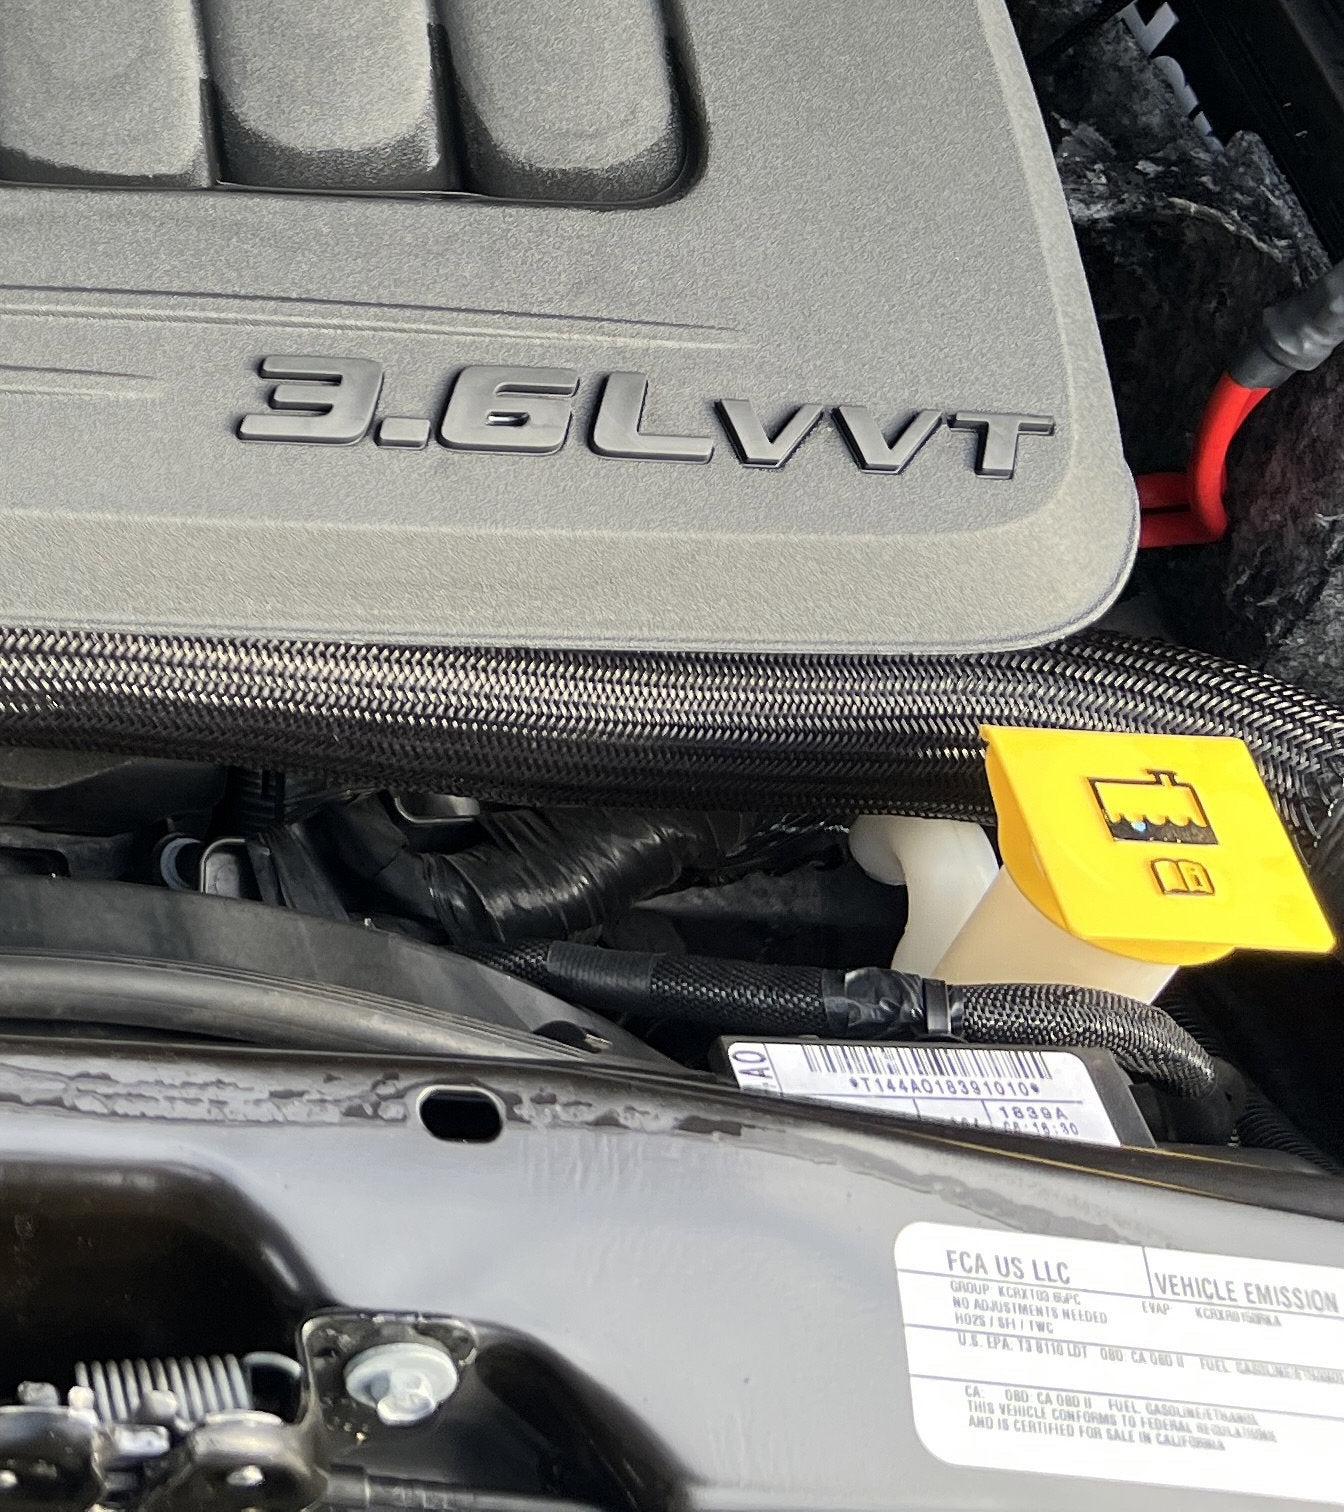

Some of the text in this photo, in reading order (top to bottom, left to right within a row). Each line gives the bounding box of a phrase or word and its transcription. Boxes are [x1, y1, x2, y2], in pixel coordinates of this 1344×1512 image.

[236, 354, 1056, 480] 3.6L VVT
[946, 1250, 1070, 1284] FCA US LLC
[1154, 1272, 1340, 1313] VEHICLE EMISSION
[953, 1296, 1107, 1324] NO ADJUSTMENTS NEEDED
[1029, 1319, 1054, 1333] TWC
[1068, 1343, 1087, 1359] LDT
[1131, 1350, 1146, 1364] CA
[968, 1399, 994, 1414] THIS
[999, 1403, 1047, 1420] VEHICLE
[1052, 1408, 1117, 1426] CONFORMS
[1122, 1414, 1136, 1428] TO
[1141, 1416, 1192, 1433] FEDERAL
[1037, 1391, 1053, 1405] CA
[1057, 1393, 1080, 1408] OBD
[968, 1415, 1226, 1451] AND IS CERTIFIED FOR SALE IN CALIFORNIA
